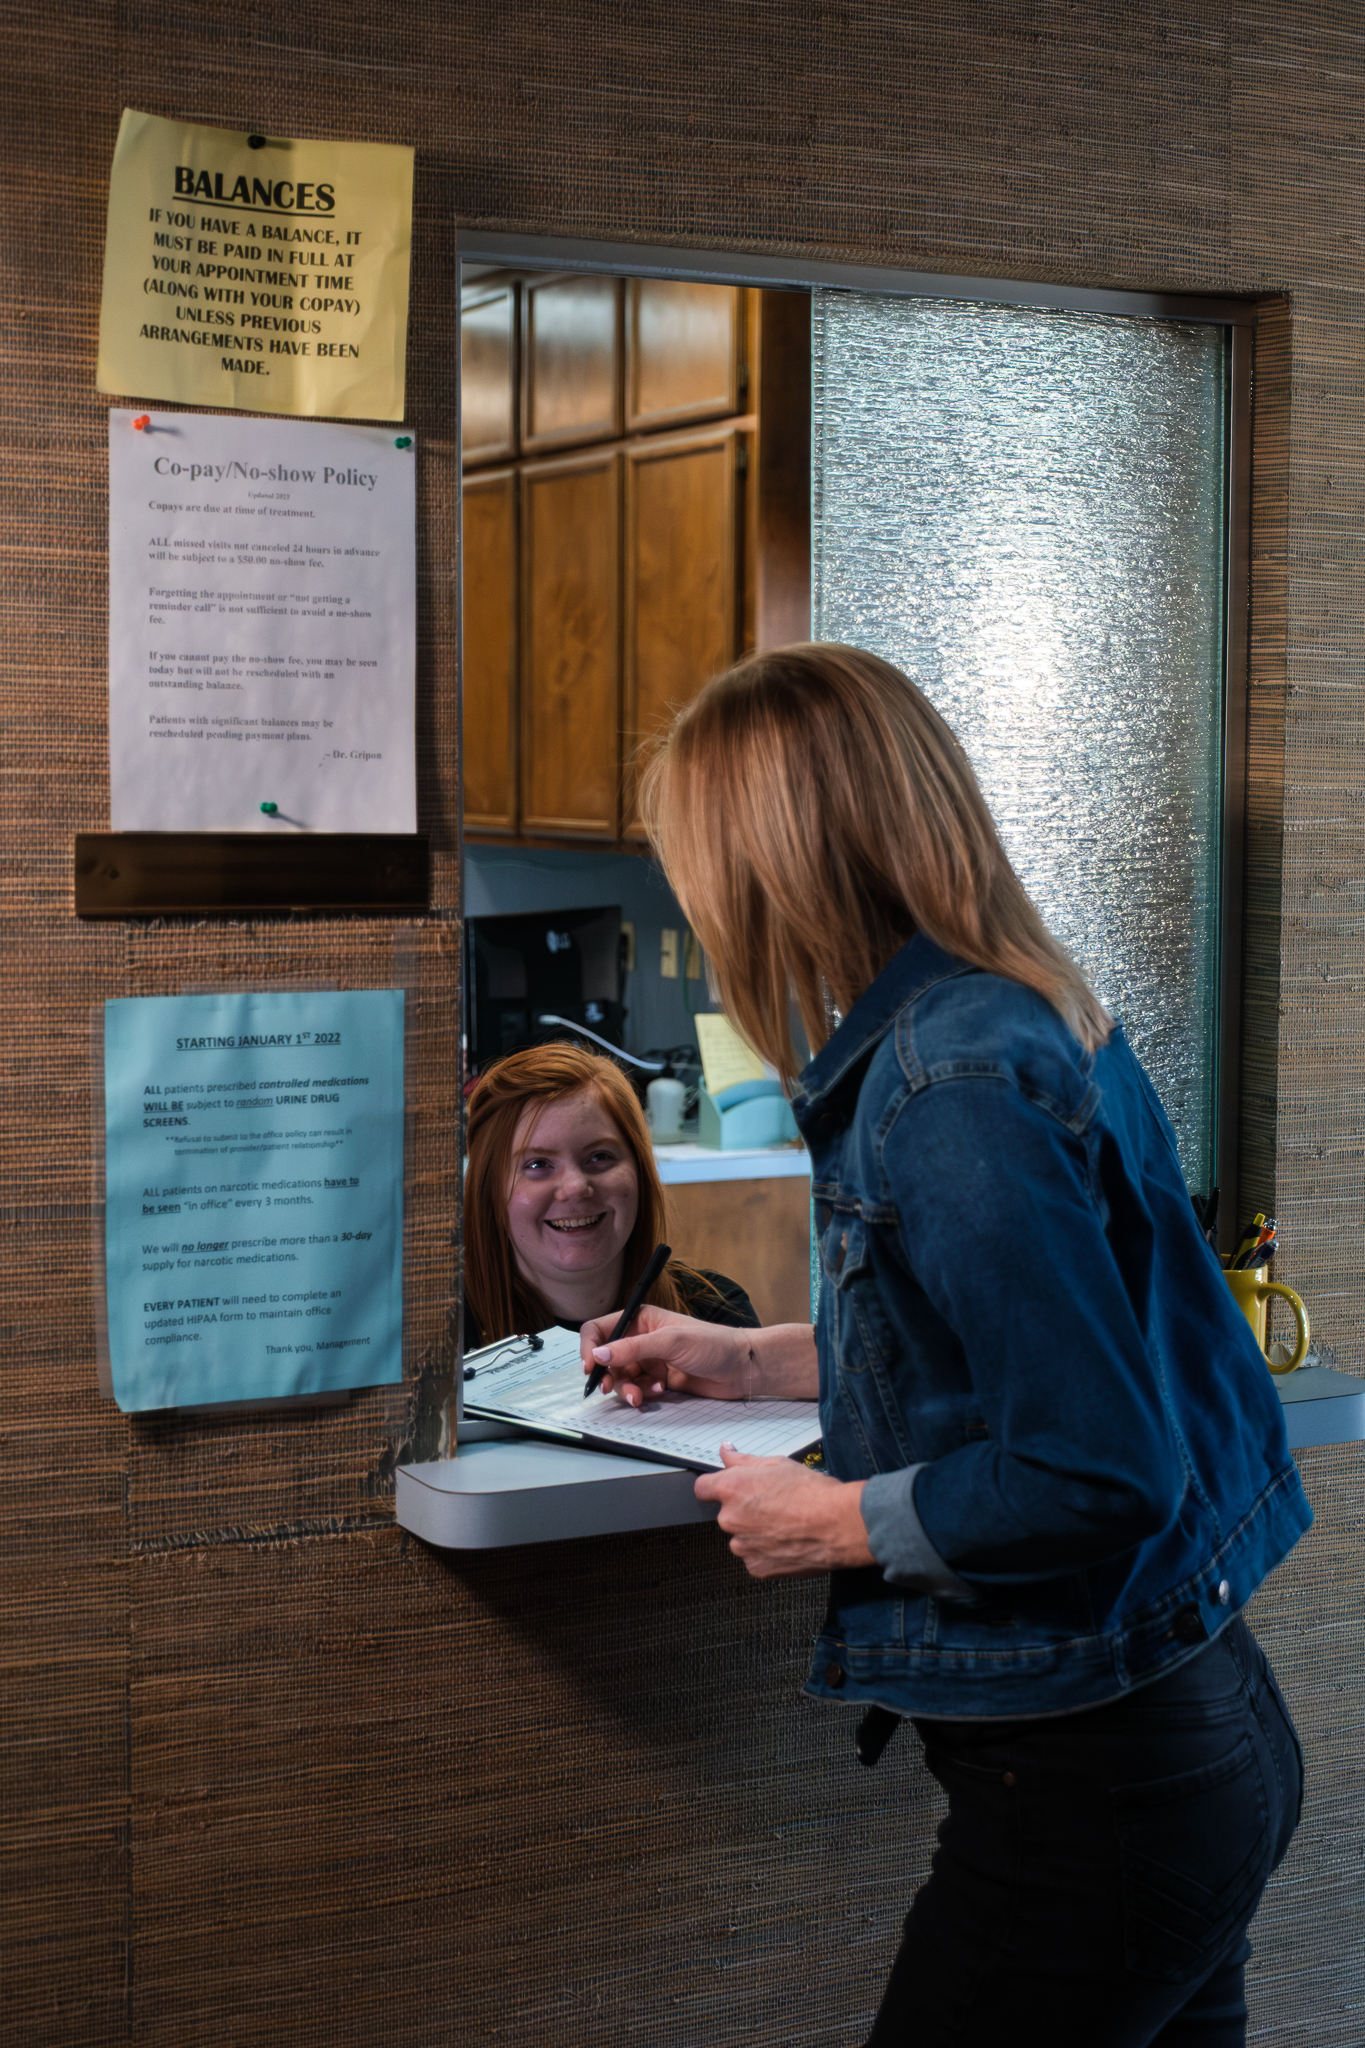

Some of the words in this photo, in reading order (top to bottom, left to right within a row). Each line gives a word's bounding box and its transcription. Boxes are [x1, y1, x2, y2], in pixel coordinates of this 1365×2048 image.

[173, 166, 335, 213] BALANCES
[149, 207, 161, 222] IF
[166, 211, 194, 228] YOU
[201, 217, 239, 234] HAVE
[246, 223, 256, 236] A
[262, 225, 339, 245] BALANCE,
[346, 231, 361, 244] IT
[153, 231, 192, 251] MUST
[198, 240, 216, 255] BE
[224, 243, 261, 259] PAID
[268, 248, 282, 262] IN
[289, 250, 328, 266] FULL
[334, 253, 354, 267] AT
[152, 254, 191, 274] YOUR
[196, 263, 308, 287] APPOINTMENT
[314, 275, 353, 290] TIME
[143, 278, 198, 298] (ALONG
[204, 286, 244, 304] WITH
[250, 291, 293, 309] YOUR
[299, 297, 360, 315] COPAY)
[175, 305, 234, 325] UNLESS
[240, 313, 320, 333] PREVIOUS
[140, 324, 263, 351] ARRANGEMENTS
[269, 339, 309, 355] HAVE
[317, 342, 358, 358] BEEN
[221, 357, 269, 375] MADE.
[153, 456, 315, 483] Co-pay/No-show
[323, 466, 378, 491] Policy
[148, 500, 183, 513] Copays
[185, 504, 201, 512] are
[203, 503, 220, 513] due
[234, 505, 255, 515] time
[257, 506, 268, 515] of
[148, 536, 171, 547] ALL
[173, 538, 205, 548] missed
[207, 540, 231, 549] visits
[292, 544, 303, 553] 24
[305, 544, 331, 554] hours
[343, 547, 380, 556] advance
[148, 550, 166, 560] will
[168, 551, 179, 561] be
[181, 552, 215, 564] subject
[269, 557, 306, 566] no-show
[148, 586, 198, 600] Forgetting
[199, 589, 215, 598] the
[216, 590, 275, 601] appointment
[312, 594, 343, 605] getting
[148, 601, 192, 611] reminder
[245, 605, 287, 615] sufficient
[289, 607, 299, 615] to
[301, 608, 326, 616] avoid
[335, 608, 372, 619] no-show
[148, 664, 174, 676] today
[177, 665, 193, 675] but
[195, 666, 212, 675] will
[214, 668, 229, 676] not
[232, 667, 243, 676] be
[245, 668, 299, 678] rescheduled
[300, 669, 321, 678] with
[323, 671, 335, 680] an
[148, 679, 203, 691] outstanding
[148, 714, 186, 724] Patients
[188, 715, 209, 725] with
[211, 716, 258, 727] significant
[260, 717, 299, 727] balances
[301, 720, 320, 729] may
[322, 718, 334, 728] be
[175, 1035, 236, 1049] STARTING
[237, 1034, 293, 1047] JANUARY
[313, 1032, 341, 1045] 2022
[143, 1085, 162, 1095] ALL
[164, 1084, 204, 1096] patients
[206, 1080, 256, 1094] prescribed
[258, 1078, 310, 1089] controlled
[311, 1075, 370, 1088] medications
[142, 1100, 170, 1113] WILL
[170, 1100, 184, 1112] BE
[185, 1099, 222, 1110] subject
[223, 1099, 234, 1107] to
[236, 1096, 274, 1108] random
[275, 1094, 308, 1105] URINE
[310, 1092, 340, 1104] DRUG
[142, 1187, 160, 1197] ALL
[162, 1185, 202, 1197] patients
[204, 1185, 217, 1193] on
[219, 1180, 259, 1192] narcotic
[261, 1179, 322, 1190] medications
[323, 1176, 348, 1189] have
[349, 1176, 360, 1188] to
[141, 1202, 155, 1216] be
[157, 1203, 181, 1214] seen
[234, 1198, 262, 1208] every
[141, 1244, 159, 1254] We
[160, 1242, 179, 1253] will
[180, 1243, 195, 1254] no
[196, 1240, 230, 1253] longer
[231, 1236, 277, 1250] prescribe
[279, 1236, 306, 1245] more
[308, 1234, 330, 1244] than
[340, 1230, 373, 1243] 30-day
[141, 1259, 174, 1272] supply
[176, 1258, 191, 1268] for
[193, 1255, 233, 1267] narcotic
[143, 1300, 175, 1312] EVERY
[176, 1296, 220, 1309] PATIENT
[221, 1295, 239, 1305] will
[241, 1293, 266, 1304] need
[268, 1294, 280, 1302] to
[281, 1290, 328, 1302] complete
[329, 1288, 342, 1300] an
[143, 1316, 184, 1329] updated
[186, 1313, 218, 1324] HIPAA
[219, 1312, 243, 1322] form
[246, 1311, 256, 1320] to
[258, 1308, 303, 1319] maintain
[304, 1304, 332, 1317] office
[265, 1343, 293, 1354] Thank
[315, 1337, 371, 1350] Management
